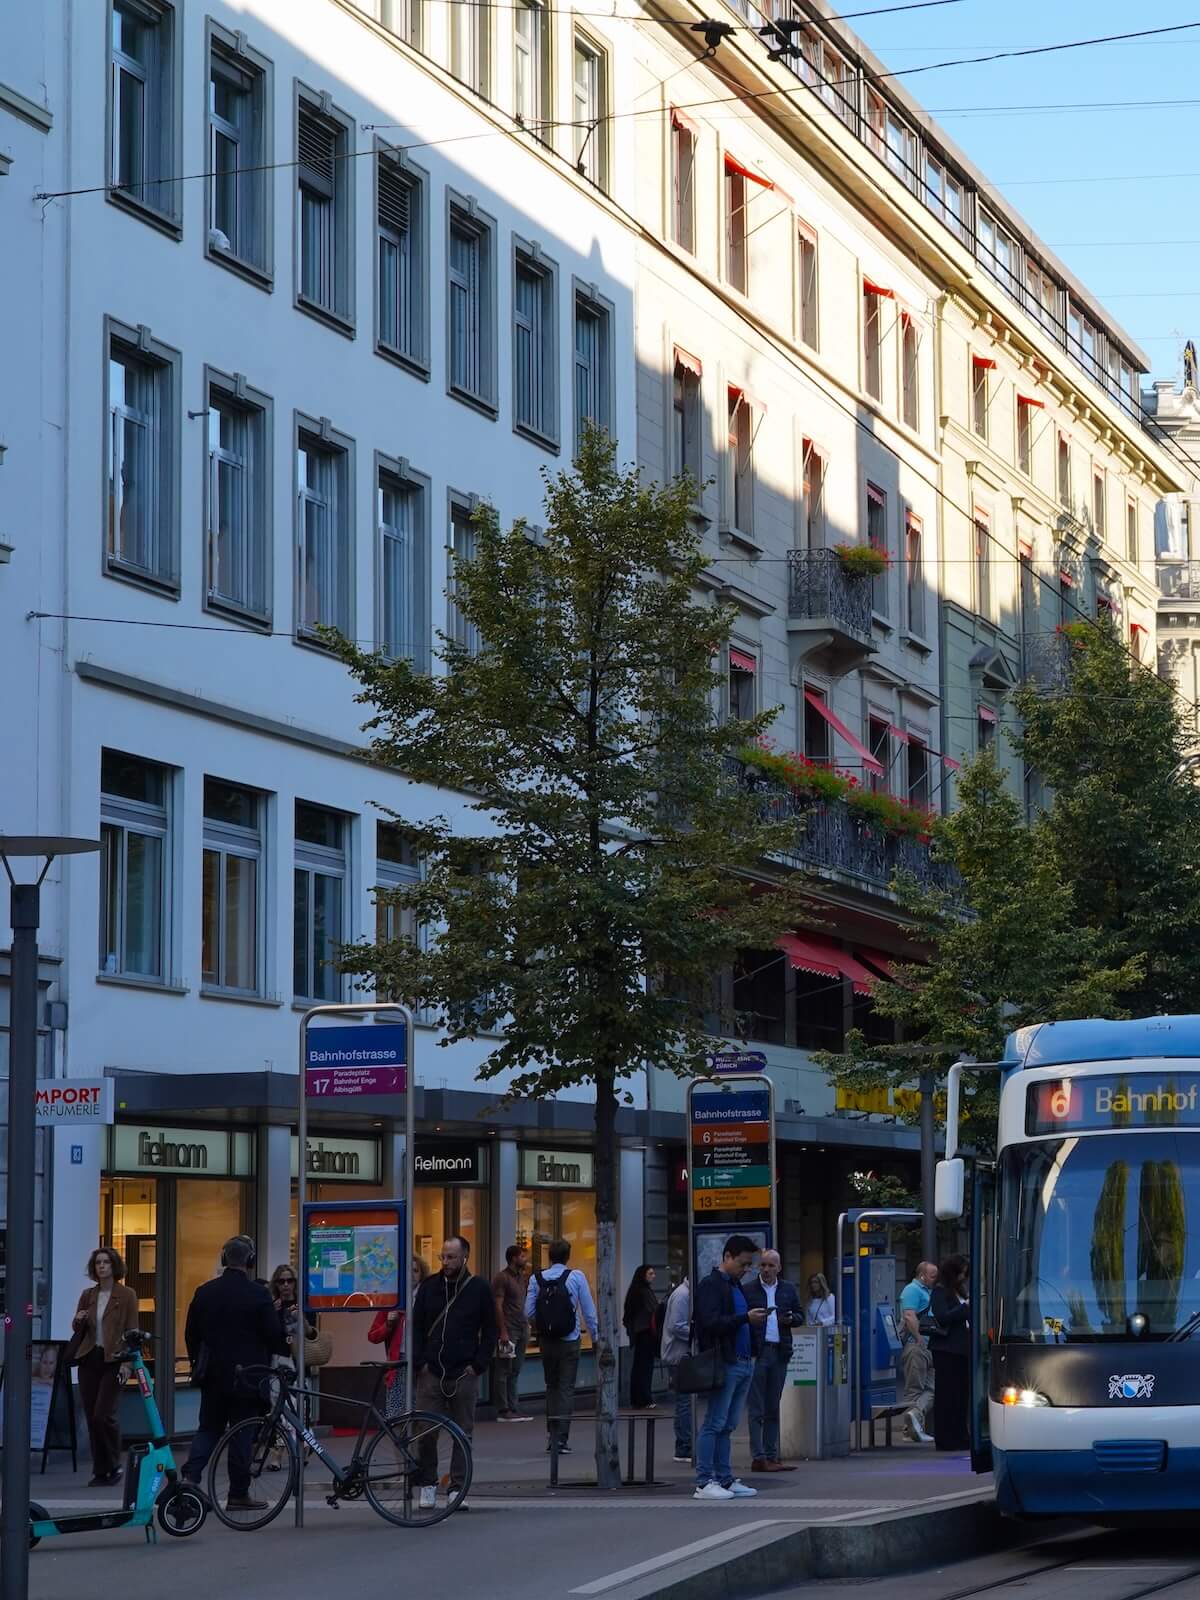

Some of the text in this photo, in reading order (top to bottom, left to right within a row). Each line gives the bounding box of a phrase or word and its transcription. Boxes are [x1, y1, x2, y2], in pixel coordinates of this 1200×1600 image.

[309, 1049, 397, 1062] Bahnhofstrasse
[313, 1079, 330, 1094] 17
[34, 1087, 101, 1104] MPORT
[1050, 1090, 1070, 1118] 6
[1095, 1084, 1198, 1112] Bahnhof
[35, 1104, 100, 1116] ARFUMERIE
[695, 1109, 762, 1119] Bahnhofstrasse
[703, 1131, 711, 1143] 6
[415, 1156, 472, 1171] fielmann
[703, 1153, 711, 1165] 7
[700, 1175, 712, 1187] 11
[699, 1196, 712, 1208] 13
